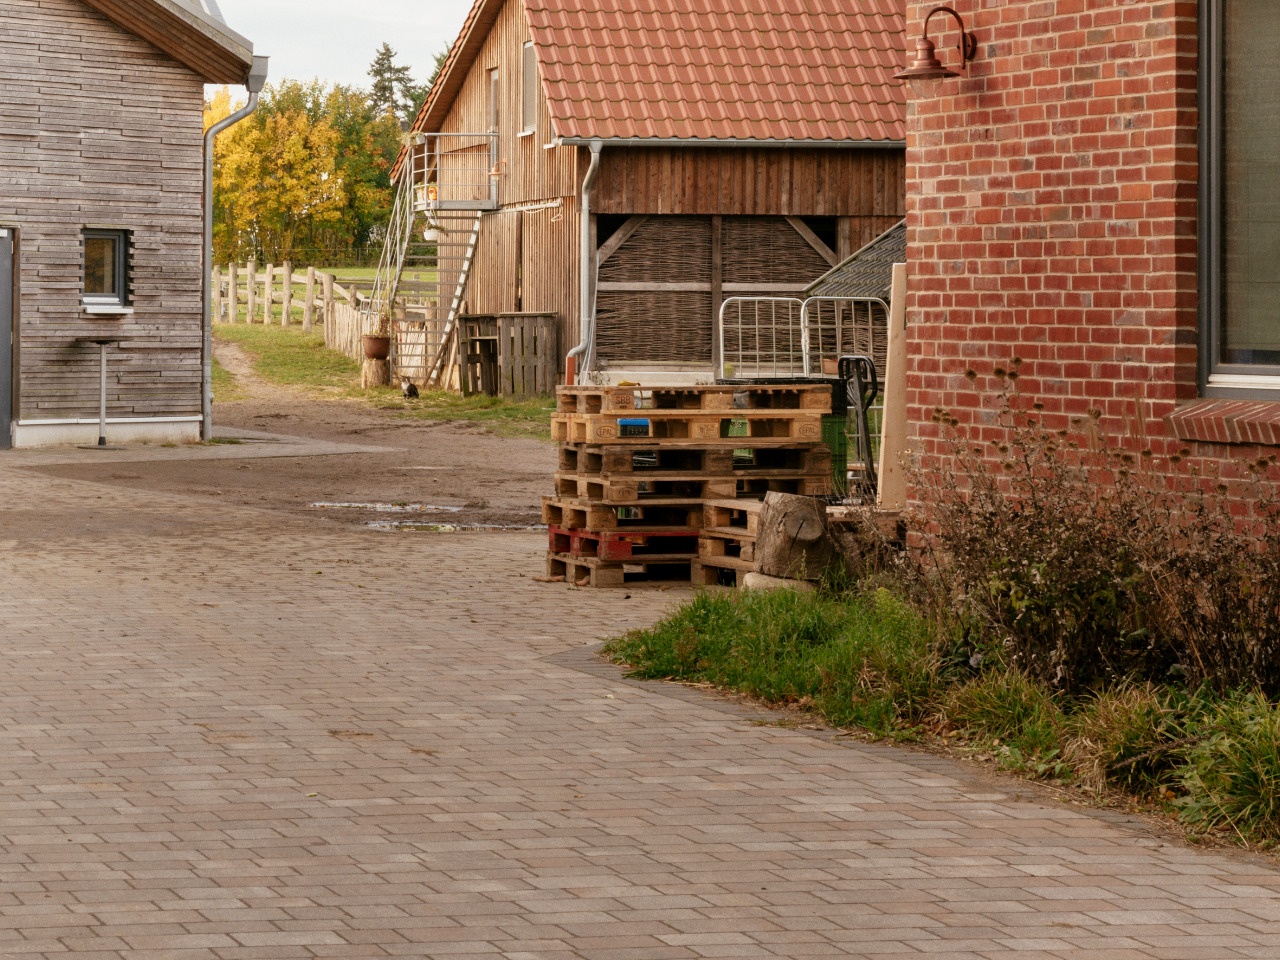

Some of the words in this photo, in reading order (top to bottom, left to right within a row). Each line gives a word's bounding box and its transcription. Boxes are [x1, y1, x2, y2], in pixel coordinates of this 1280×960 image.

[615, 395, 631, 405] SBB
[599, 428, 614, 436] EPAL
[802, 426, 816, 434] EPAL
